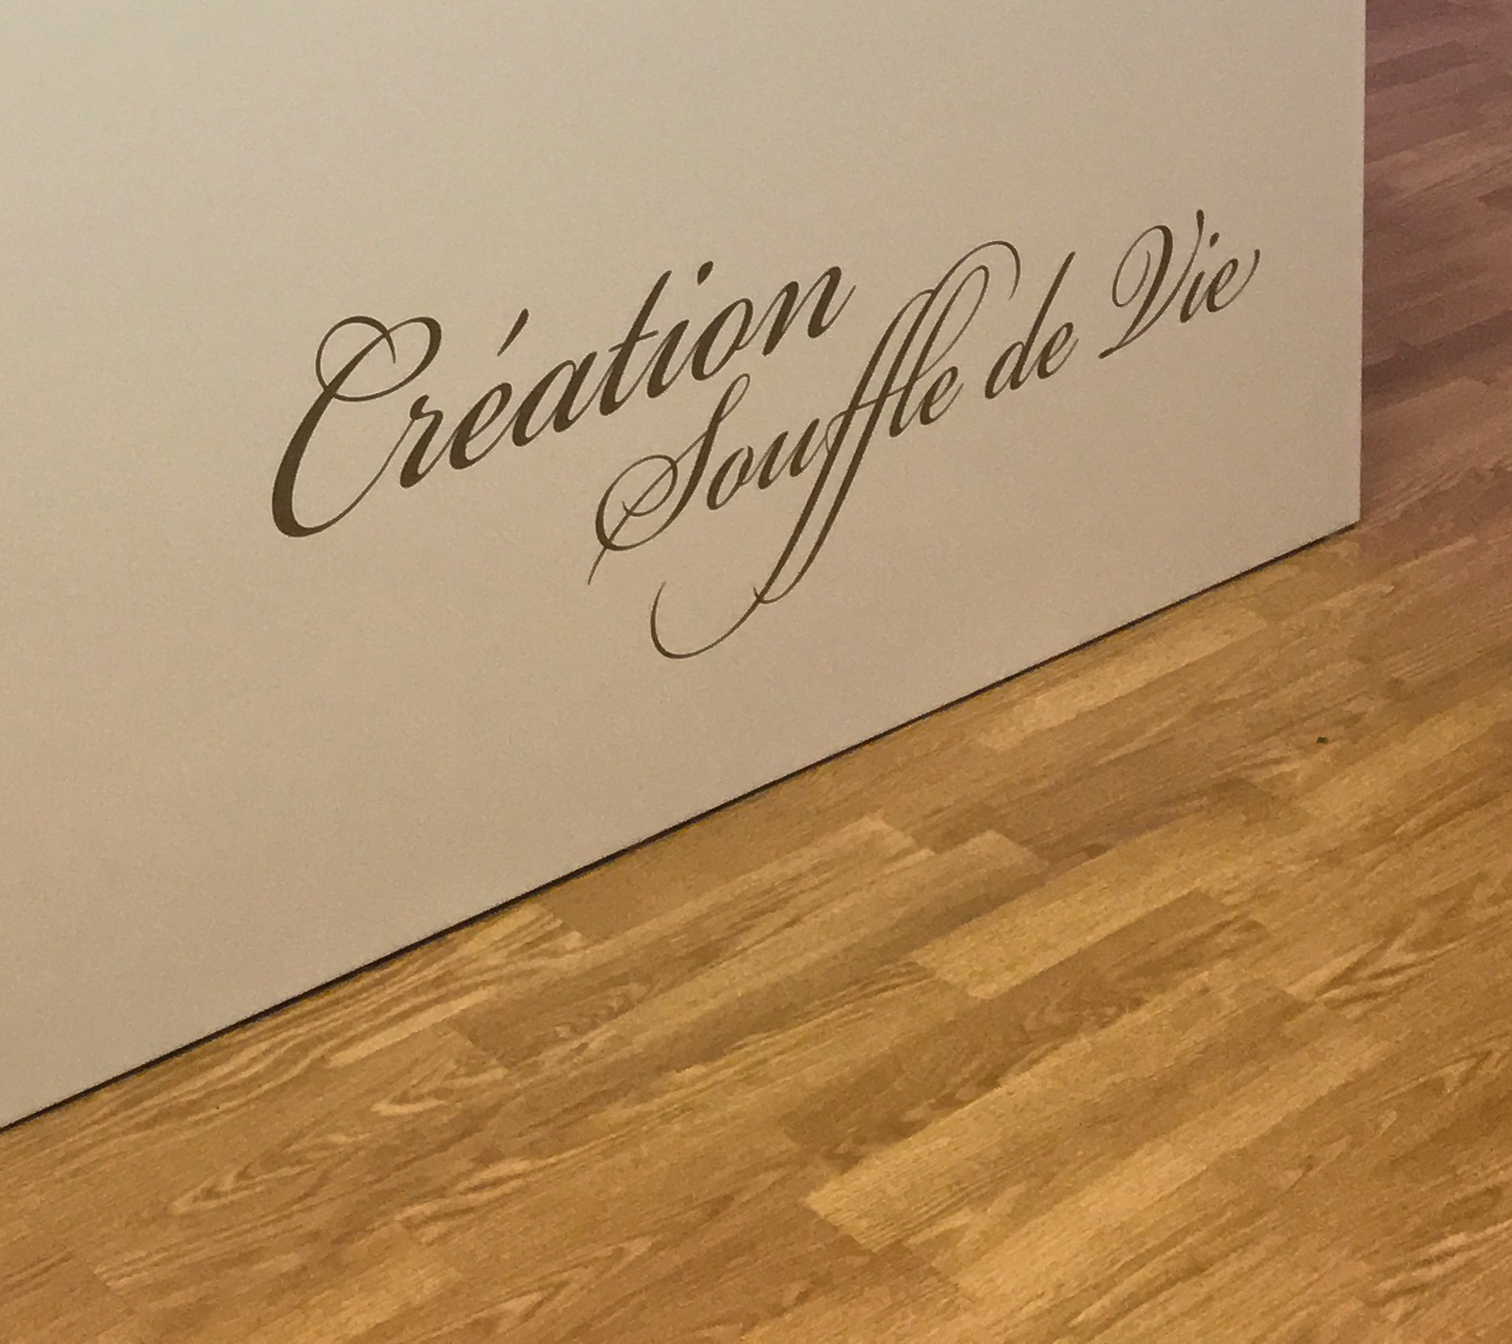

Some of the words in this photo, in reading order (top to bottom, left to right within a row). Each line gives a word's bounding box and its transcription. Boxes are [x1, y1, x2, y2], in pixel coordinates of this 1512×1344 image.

[271, 260, 857, 538] Création
[587, 240, 1022, 660] Souffle
[984, 250, 1079, 400] de
[1099, 209, 1261, 361] Vie
